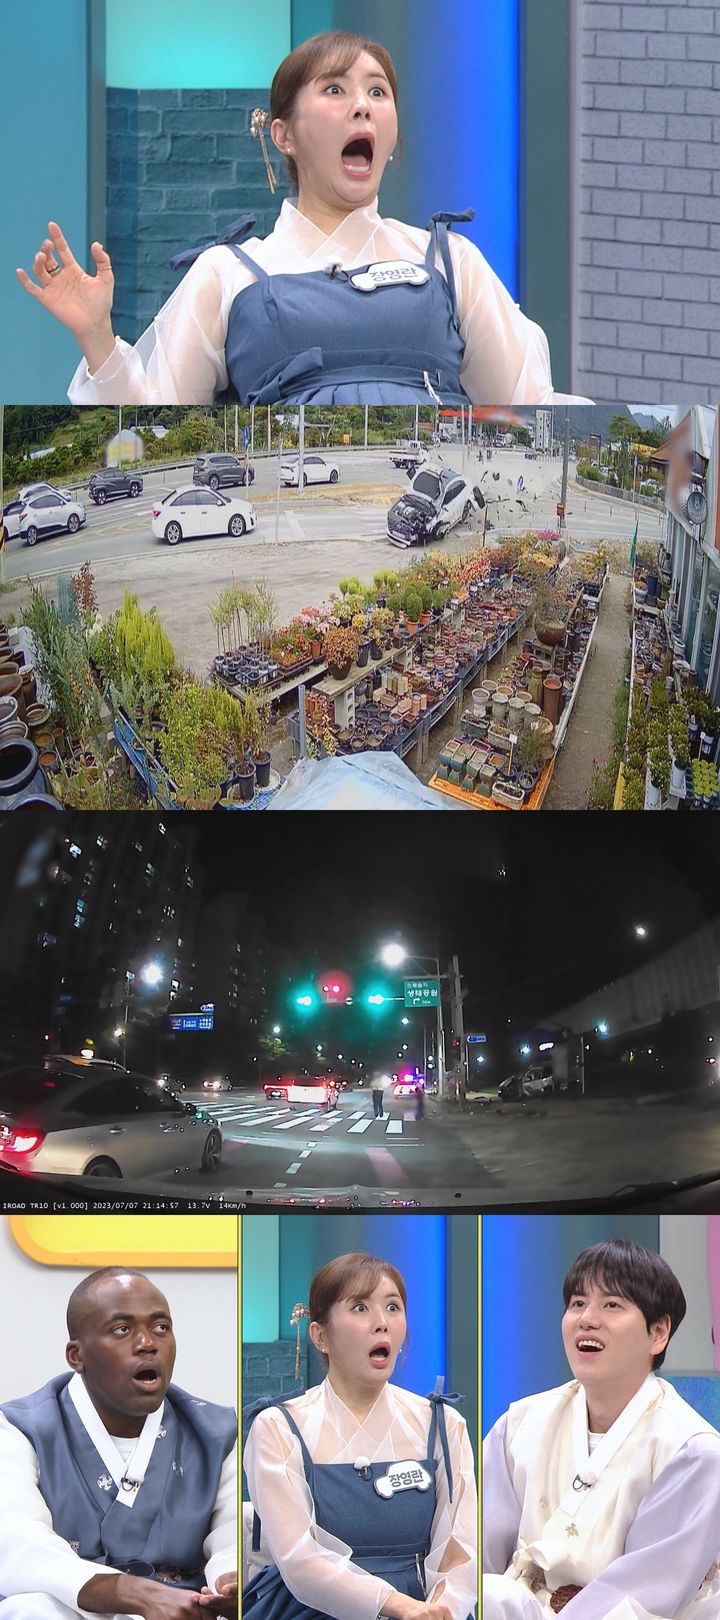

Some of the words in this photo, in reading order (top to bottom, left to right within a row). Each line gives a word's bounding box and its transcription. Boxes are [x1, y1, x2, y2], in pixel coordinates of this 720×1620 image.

[369, 267, 418, 281] 장영란
[407, 989, 438, 998] 생태공원
[389, 1469, 424, 1488] 장영란
